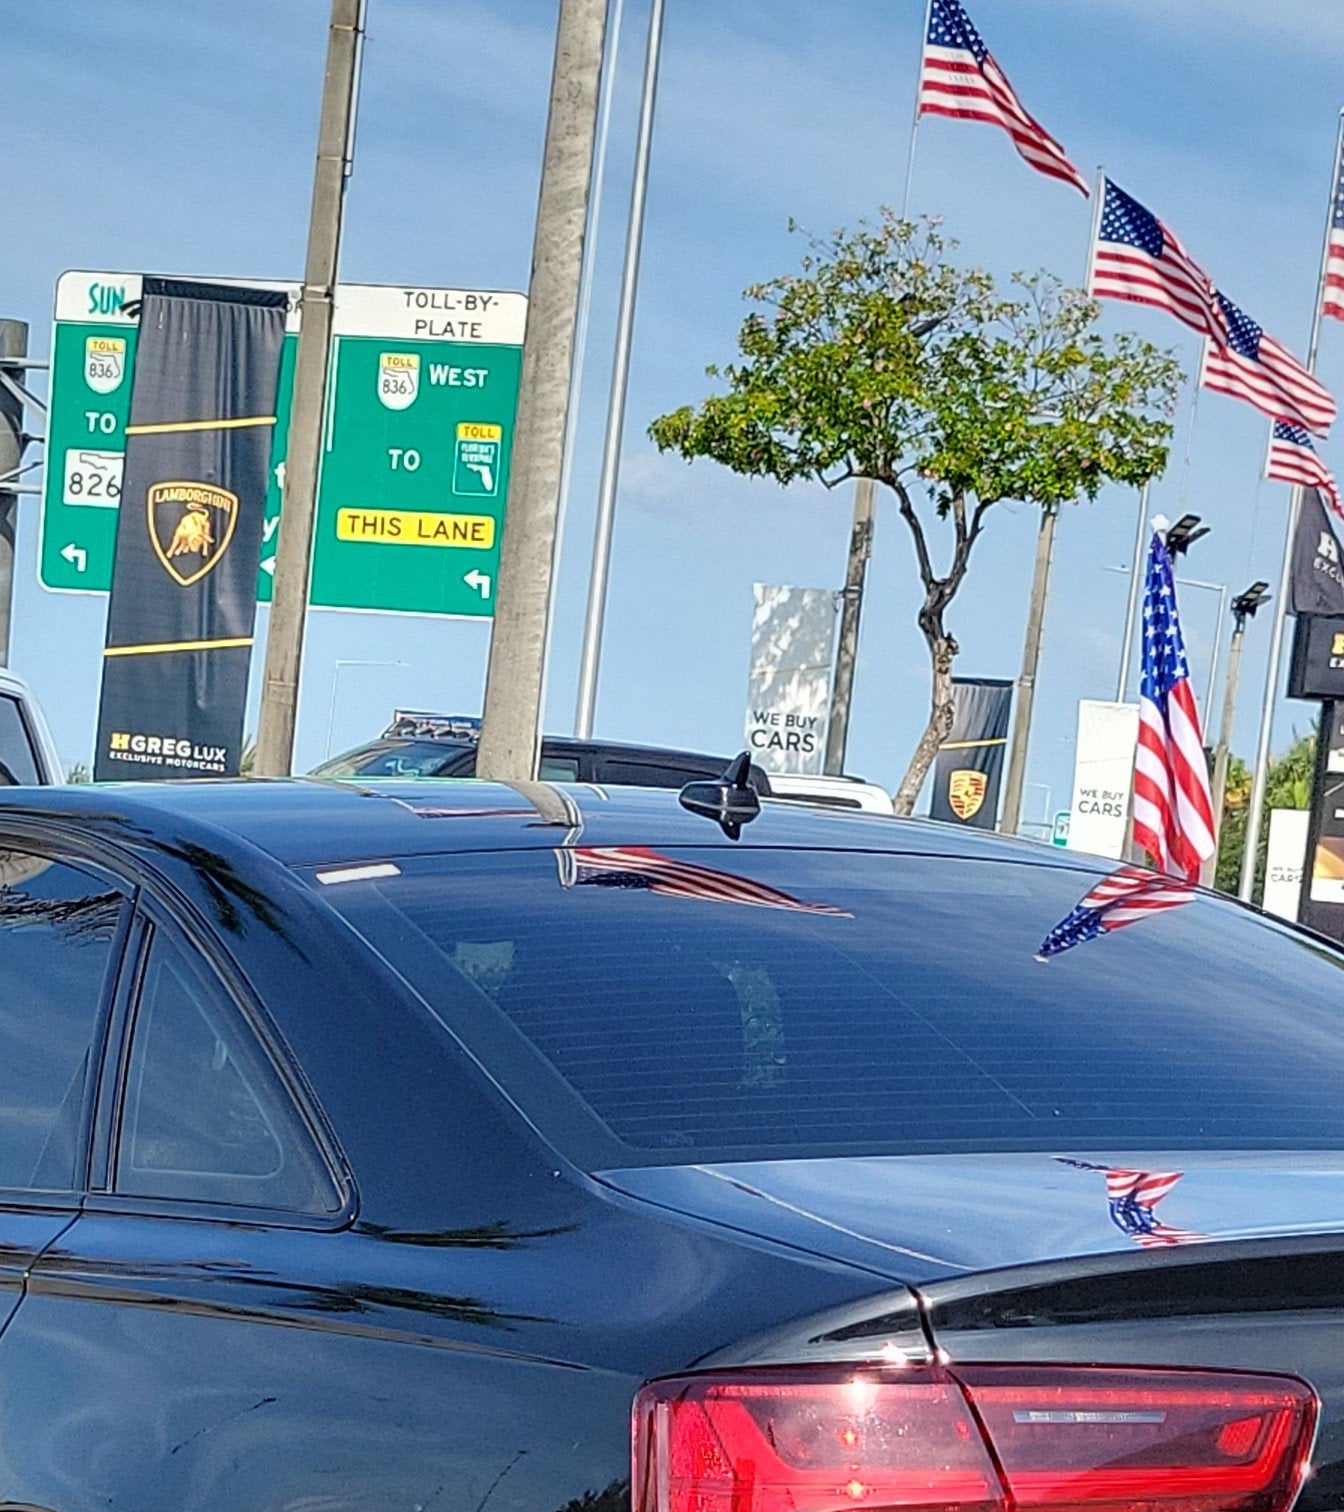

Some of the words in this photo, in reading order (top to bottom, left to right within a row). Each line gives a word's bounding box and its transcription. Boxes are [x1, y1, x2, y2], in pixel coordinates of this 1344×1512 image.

[404, 291, 499, 312] TOLL-BY-
[414, 319, 482, 338] PLATE
[92, 341, 119, 352] TOLL
[89, 363, 113, 378] 836
[386, 356, 413, 368] TOLL
[429, 363, 489, 389] WEST
[382, 378, 406, 395] 836
[85, 411, 117, 434] TO
[463, 425, 495, 438] TOLL
[388, 448, 421, 471] TO
[68, 471, 121, 497] 826
[347, 514, 402, 537] THIS
[418, 518, 486, 542] LANE
[753, 711, 781, 726] WE
[785, 714, 818, 730] BUY
[751, 729, 815, 753] CARS
[109, 751, 163, 766] EXCLUSIVE
[165, 757, 225, 772] MOTORCARS
[193, 745, 226, 762] LUX
[1080, 788, 1098, 799] WE
[1101, 790, 1124, 800] BUY
[1078, 801, 1123, 818] CARS
